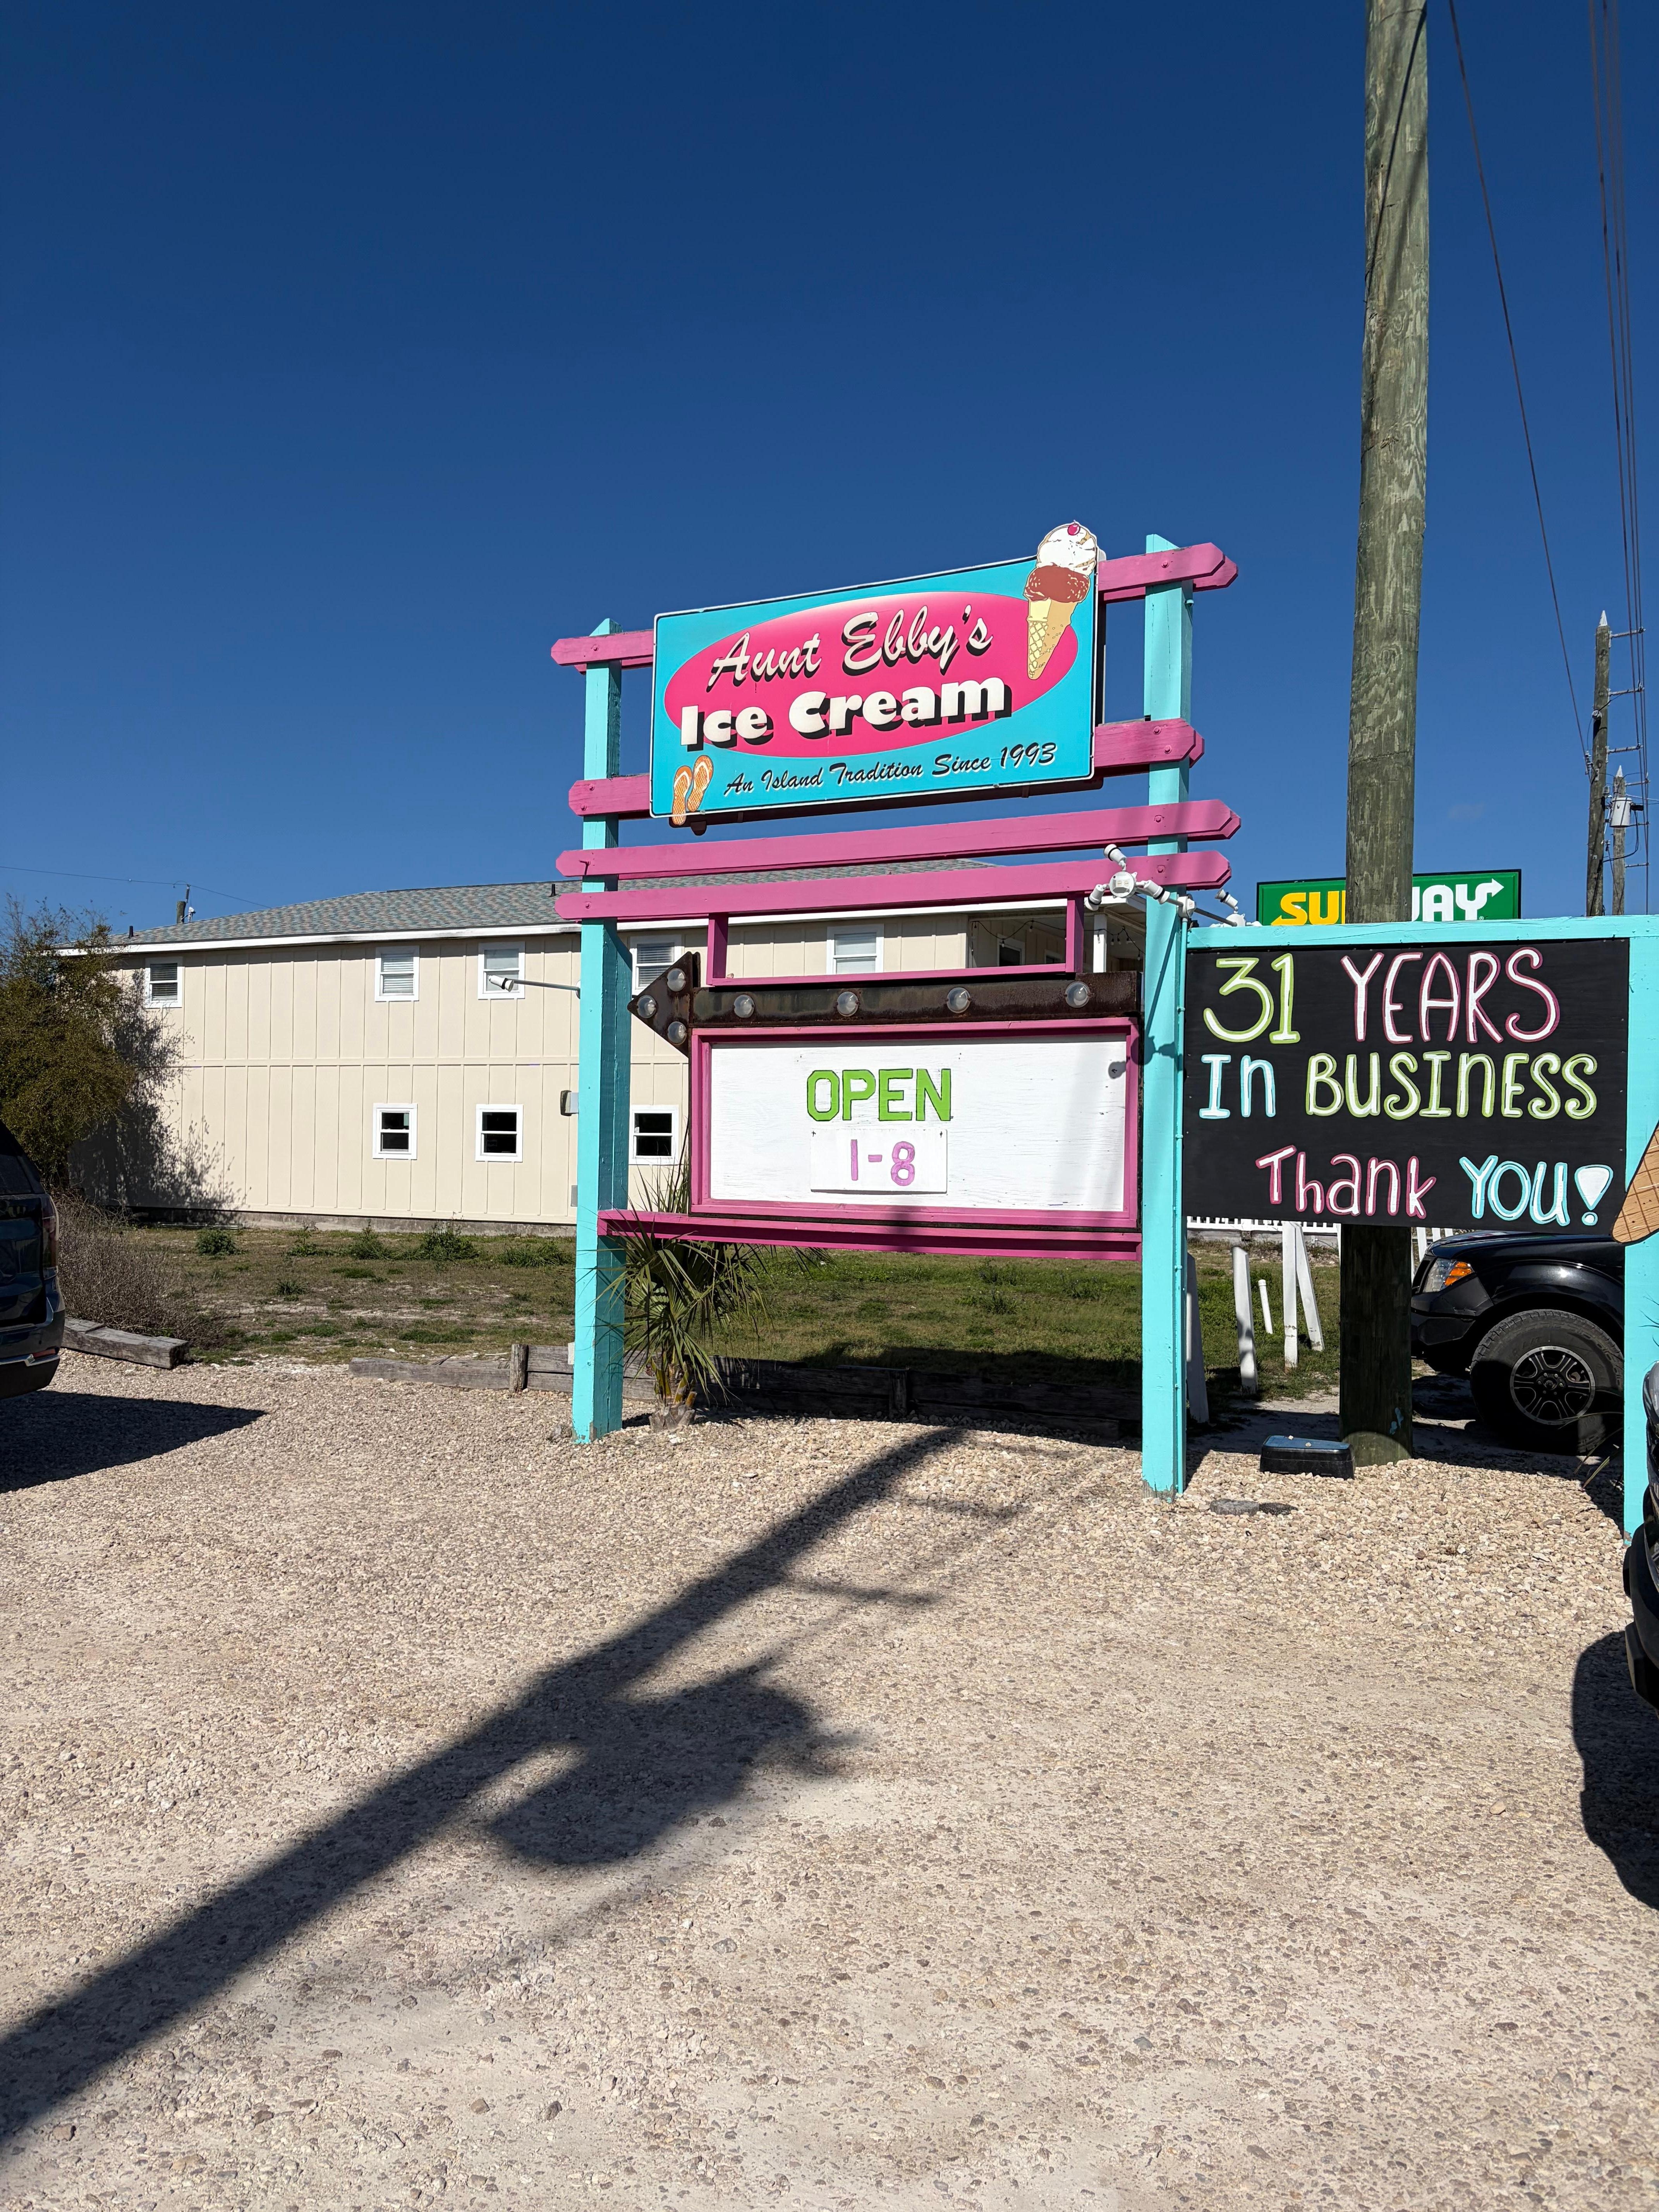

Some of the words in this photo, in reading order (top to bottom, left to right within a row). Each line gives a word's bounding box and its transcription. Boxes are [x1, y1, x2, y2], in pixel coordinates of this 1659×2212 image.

[708, 631, 822, 689] Aunt
[843, 604, 994, 671] Ebby's
[680, 704, 770, 747] Ice
[788, 676, 1007, 734] Cream
[723, 772, 754, 796] An
[761, 767, 823, 792] Island
[829, 761, 923, 785] Tradition
[932, 754, 991, 776] Since
[1000, 742, 1057, 769] 1993
[1271, 878, 1504, 926] SUAY
[1203, 953, 1301, 1044] 31
[1340, 946, 1561, 1044] YEARS
[807, 1068, 953, 1121] OPEN
[1199, 1053, 1276, 1120] In
[850, 1139, 916, 1186] 1-8
[1255, 1144, 1437, 1219] Thank
[1459, 1154, 1614, 1227] YOU!
